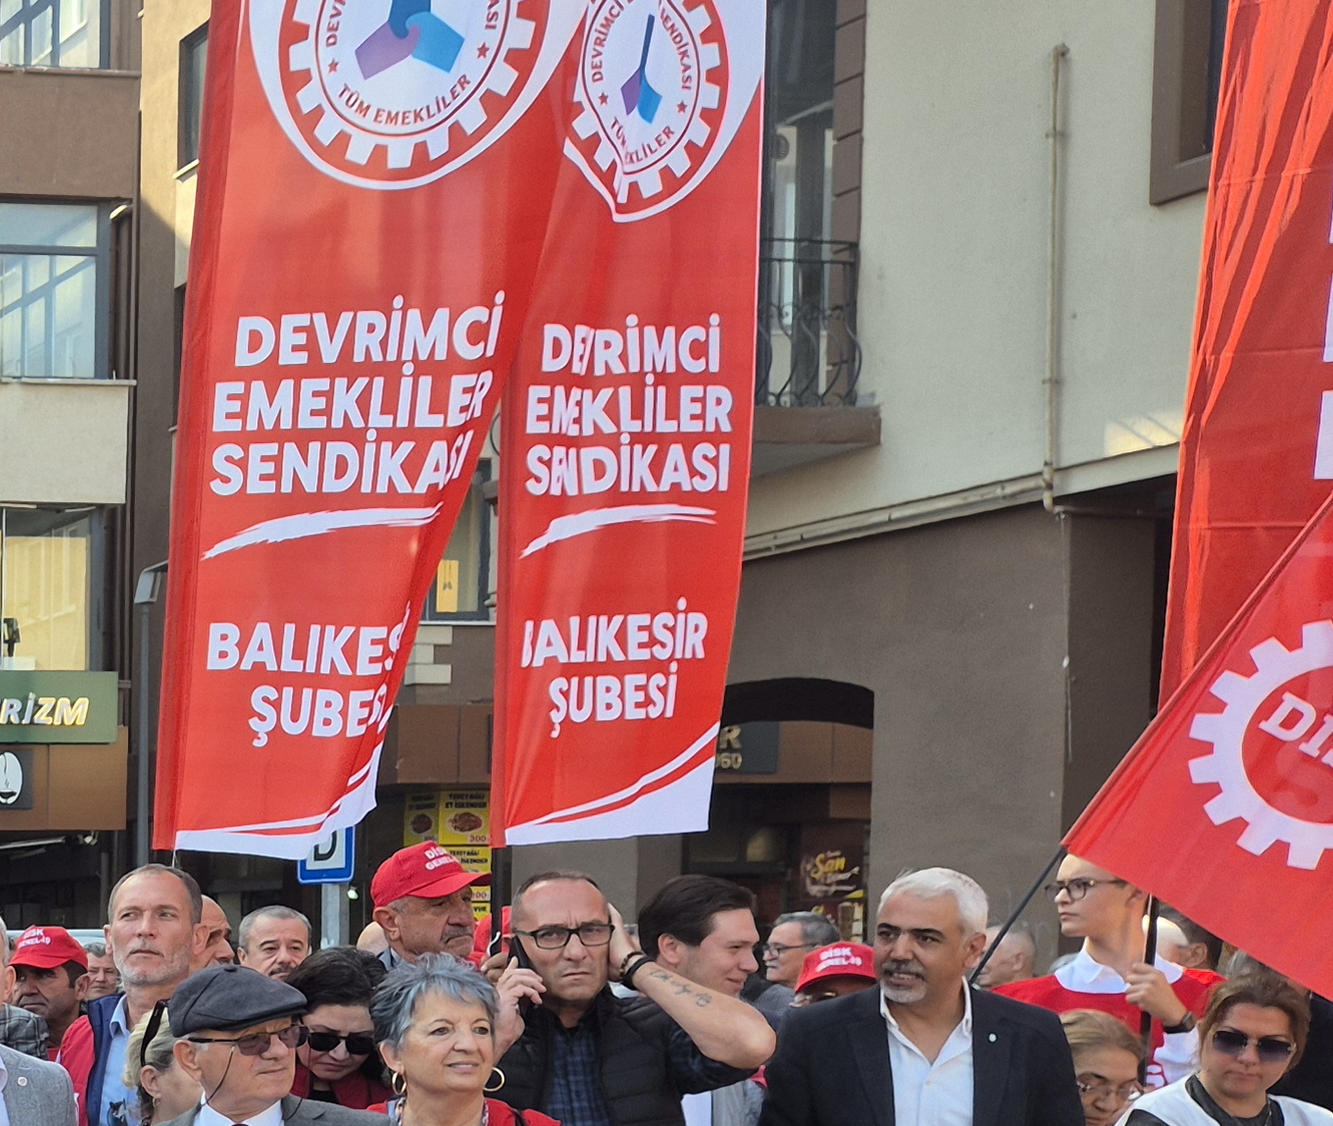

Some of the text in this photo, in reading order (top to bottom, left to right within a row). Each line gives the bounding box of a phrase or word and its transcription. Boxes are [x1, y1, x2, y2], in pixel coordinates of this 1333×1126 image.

[338, 74, 472, 127] TÜM EMEKLİLER
[234, 290, 506, 367] DEVRİMCİ
[212, 361, 493, 432] EMEKLİLER
[209, 428, 474, 496] SENDİKASI
[206, 600, 410, 677] BALIKES
[548, 660, 679, 738] ŞUBESİ
